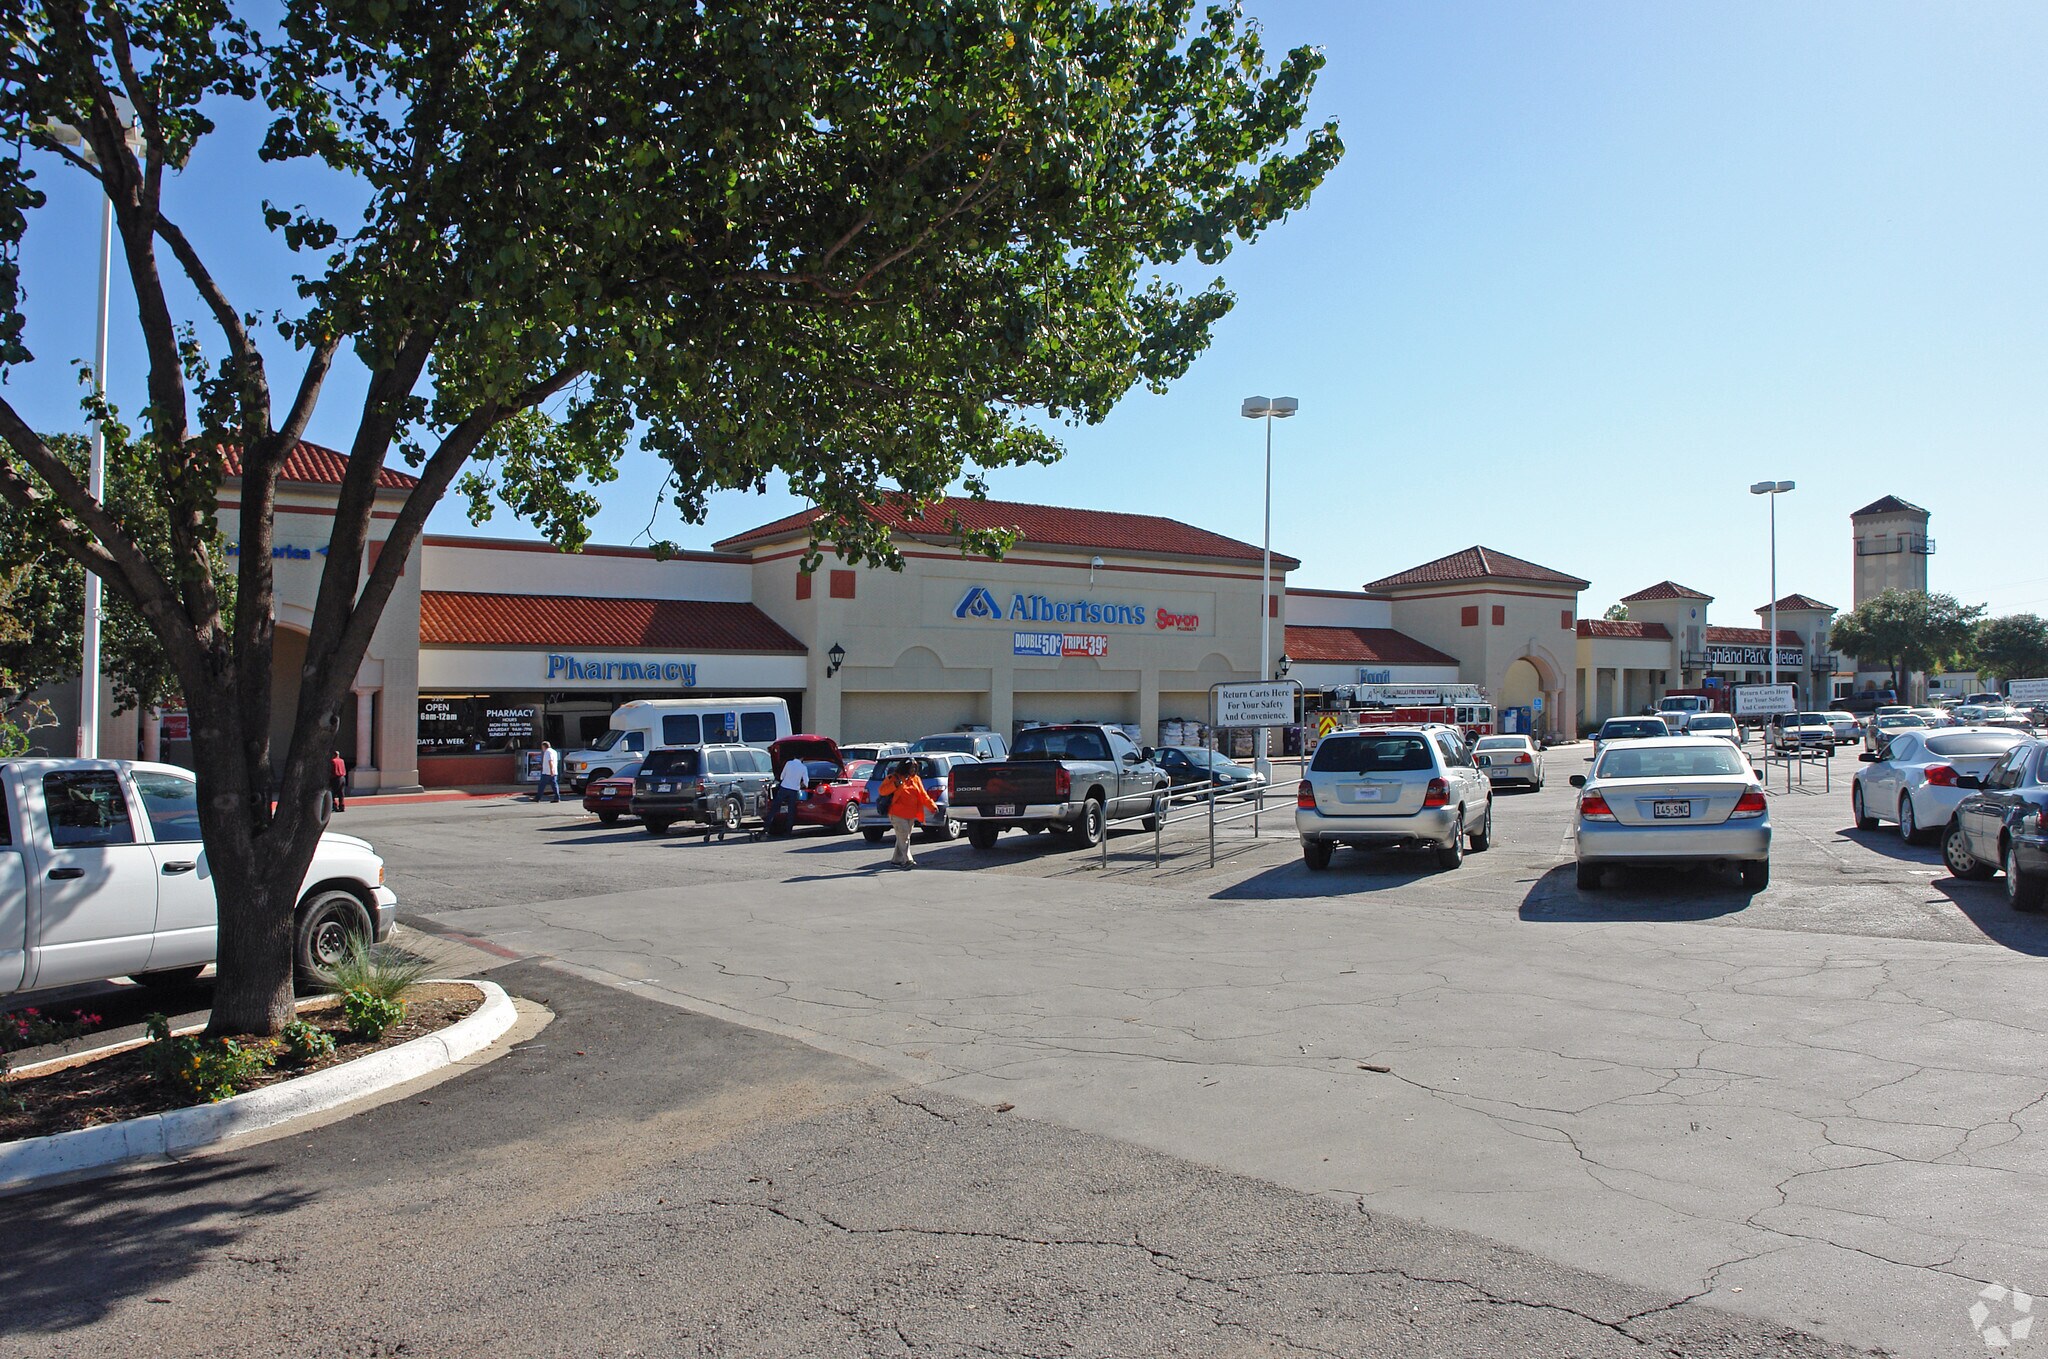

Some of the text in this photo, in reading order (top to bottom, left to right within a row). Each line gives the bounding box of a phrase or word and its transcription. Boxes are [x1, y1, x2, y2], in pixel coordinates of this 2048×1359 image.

[1007, 592, 1146, 626] Albertsons
[1015, 633, 1042, 648] DOUBLE
[1064, 635, 1088, 650] TRIPLE
[1744, 648, 1766, 664] Park
[547, 654, 697, 687] Pharmacy
[1222, 689, 1289, 699] Return Carts Here
[425, 703, 450, 712] OPEN
[1227, 700, 1283, 710] For Your Safety
[420, 712, 457, 721] 6am-12am
[486, 709, 534, 718] PHARMACY
[1224, 711, 1288, 721] And Convenience.
